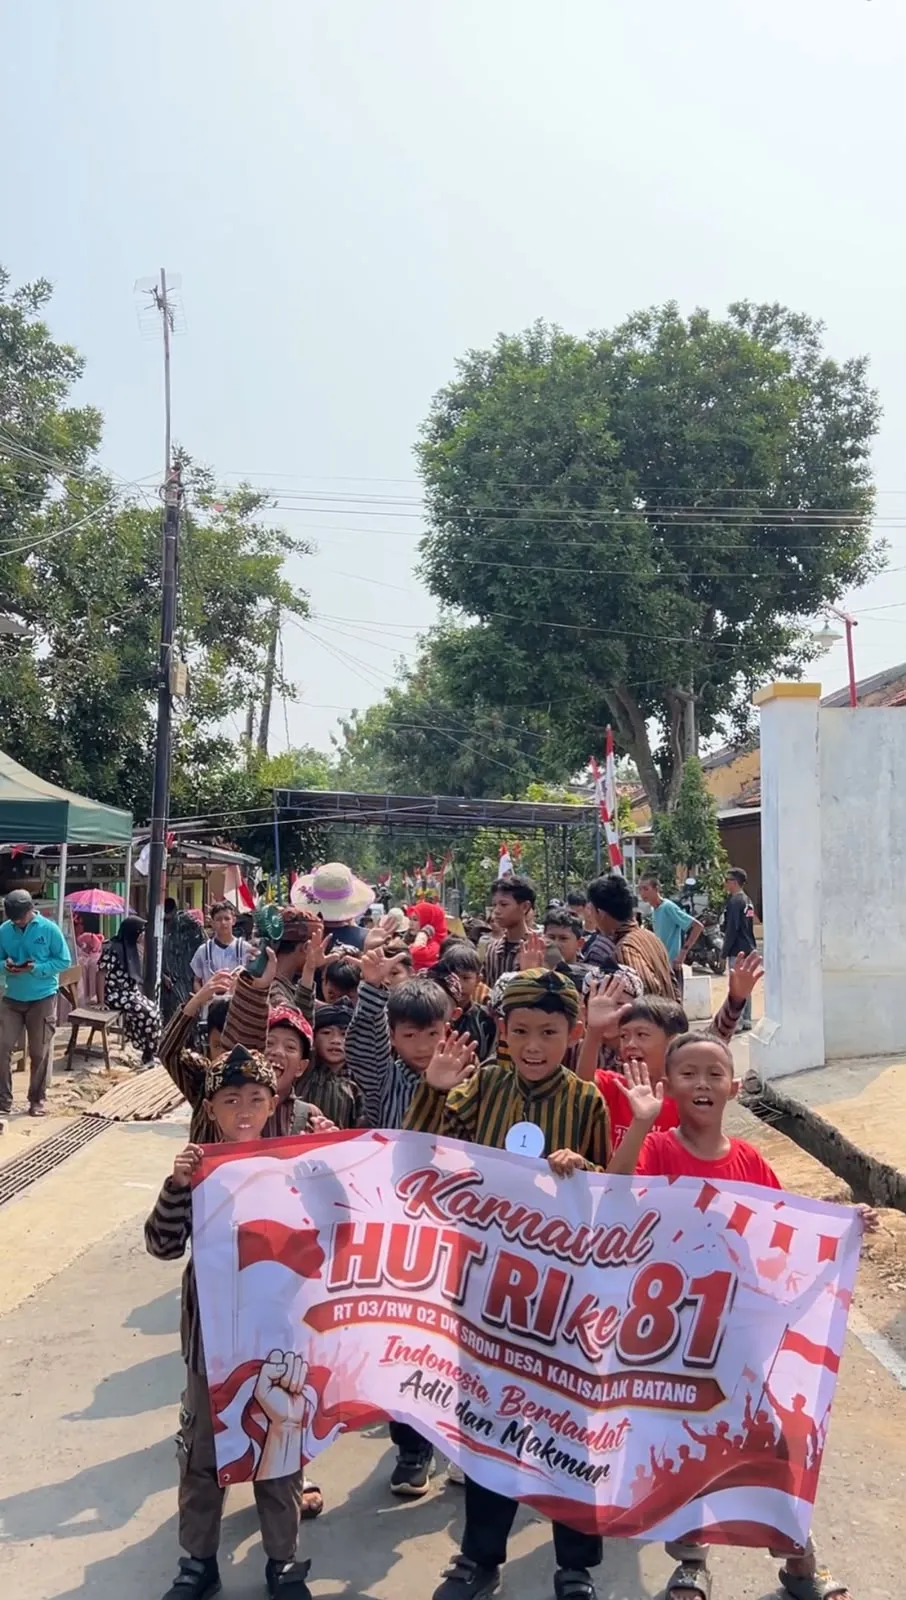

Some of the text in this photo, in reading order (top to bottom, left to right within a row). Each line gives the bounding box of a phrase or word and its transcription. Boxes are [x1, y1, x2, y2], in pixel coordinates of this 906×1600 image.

[519, 1134, 527, 1148] 1
[396, 1167, 660, 1267] Karnaval
[328, 1221, 738, 1368] HUT RI ke 81
[333, 1301, 697, 1404] RT 03/RW 02 DK SRONI DESA KALISALAK BATANG
[379, 1335, 632, 1451] Indonesia Berdaulat
[399, 1370, 611, 1484] Adil dan Makmur
